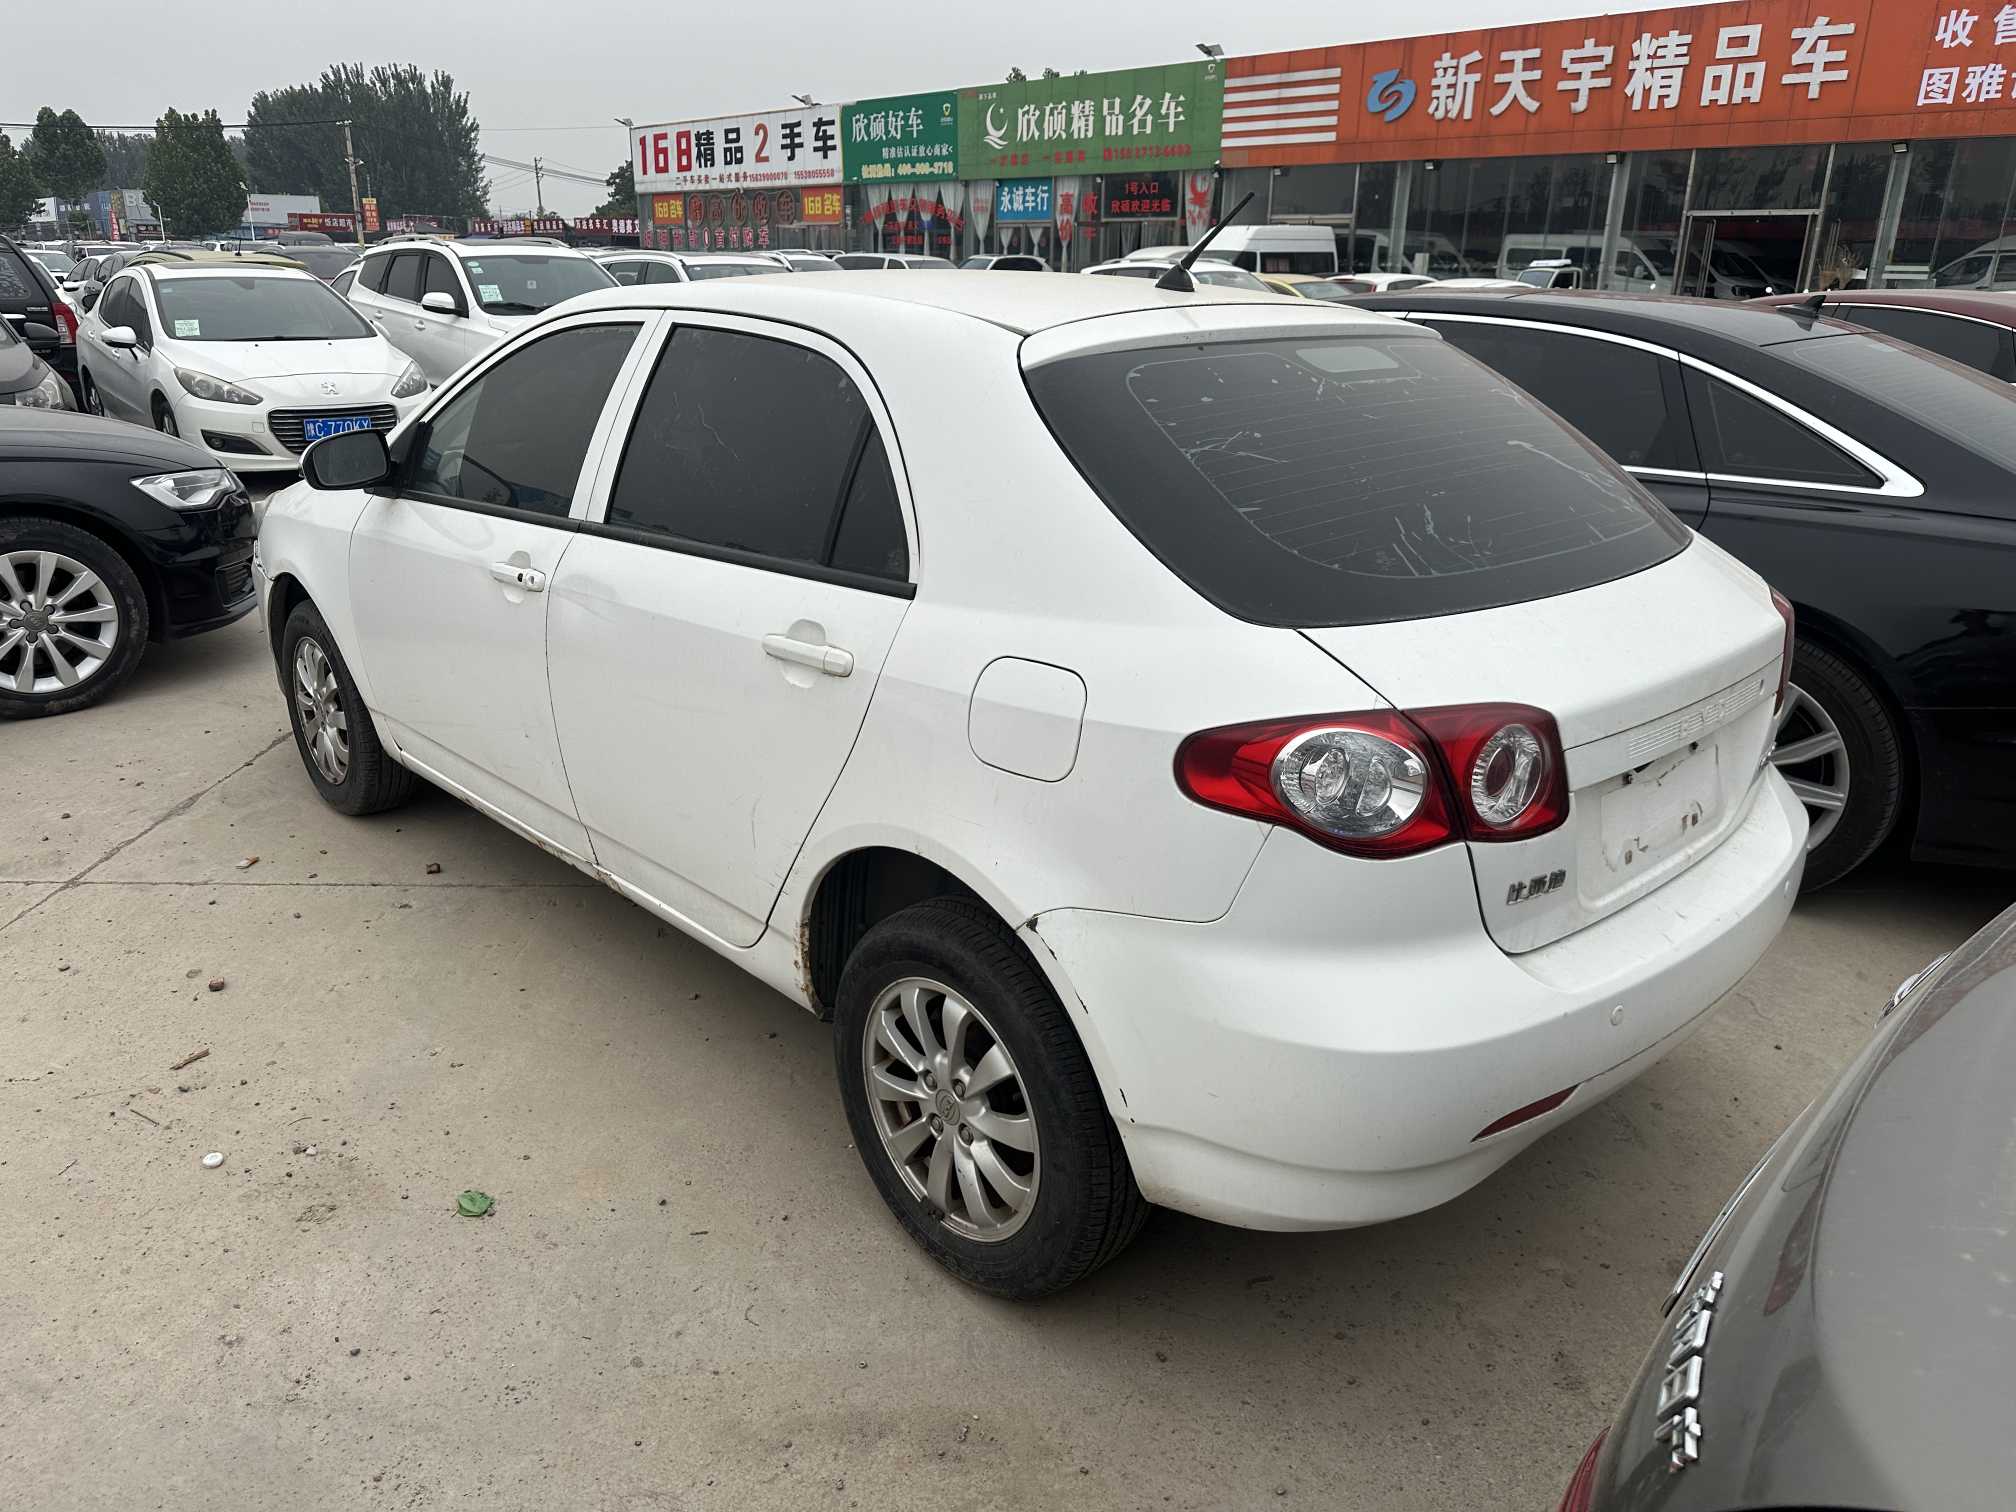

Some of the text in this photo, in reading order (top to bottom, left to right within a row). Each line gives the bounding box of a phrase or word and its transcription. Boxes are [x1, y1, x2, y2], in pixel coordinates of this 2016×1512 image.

[1427, 16, 1856, 121] 新天宇精品车
[1917, 62, 2016, 106] 图雅
[852, 107, 924, 143] 欣硕好车
[1016, 92, 1186, 142] 欣硕精品名车
[655, 198, 684, 219] 168名车
[804, 192, 841, 216] 168名车
[1000, 185, 1048, 213] 永诚车行
